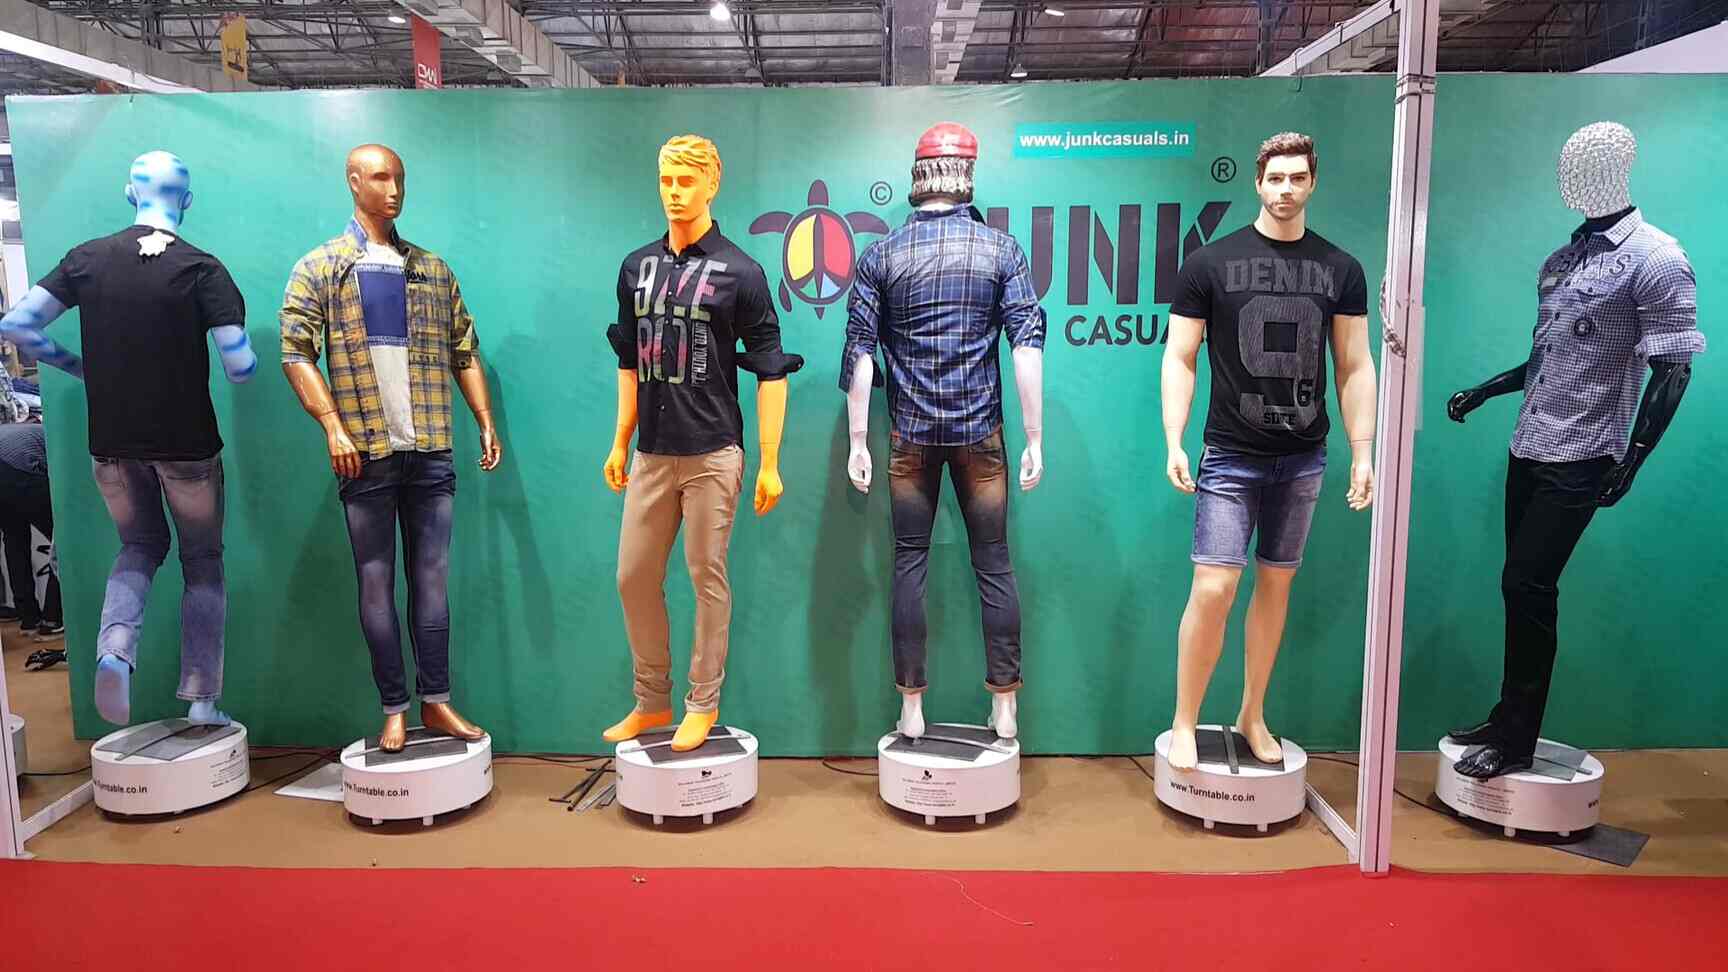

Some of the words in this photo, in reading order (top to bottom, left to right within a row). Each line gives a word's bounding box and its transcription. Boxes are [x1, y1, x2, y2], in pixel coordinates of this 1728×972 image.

[1019, 130, 1189, 150] www.junkcasuals.in
[986, 201, 1232, 306] UNK
[1225, 257, 1336, 297] DENIM
[1065, 314, 1171, 346] CASU
[1238, 295, 1323, 430] 9
